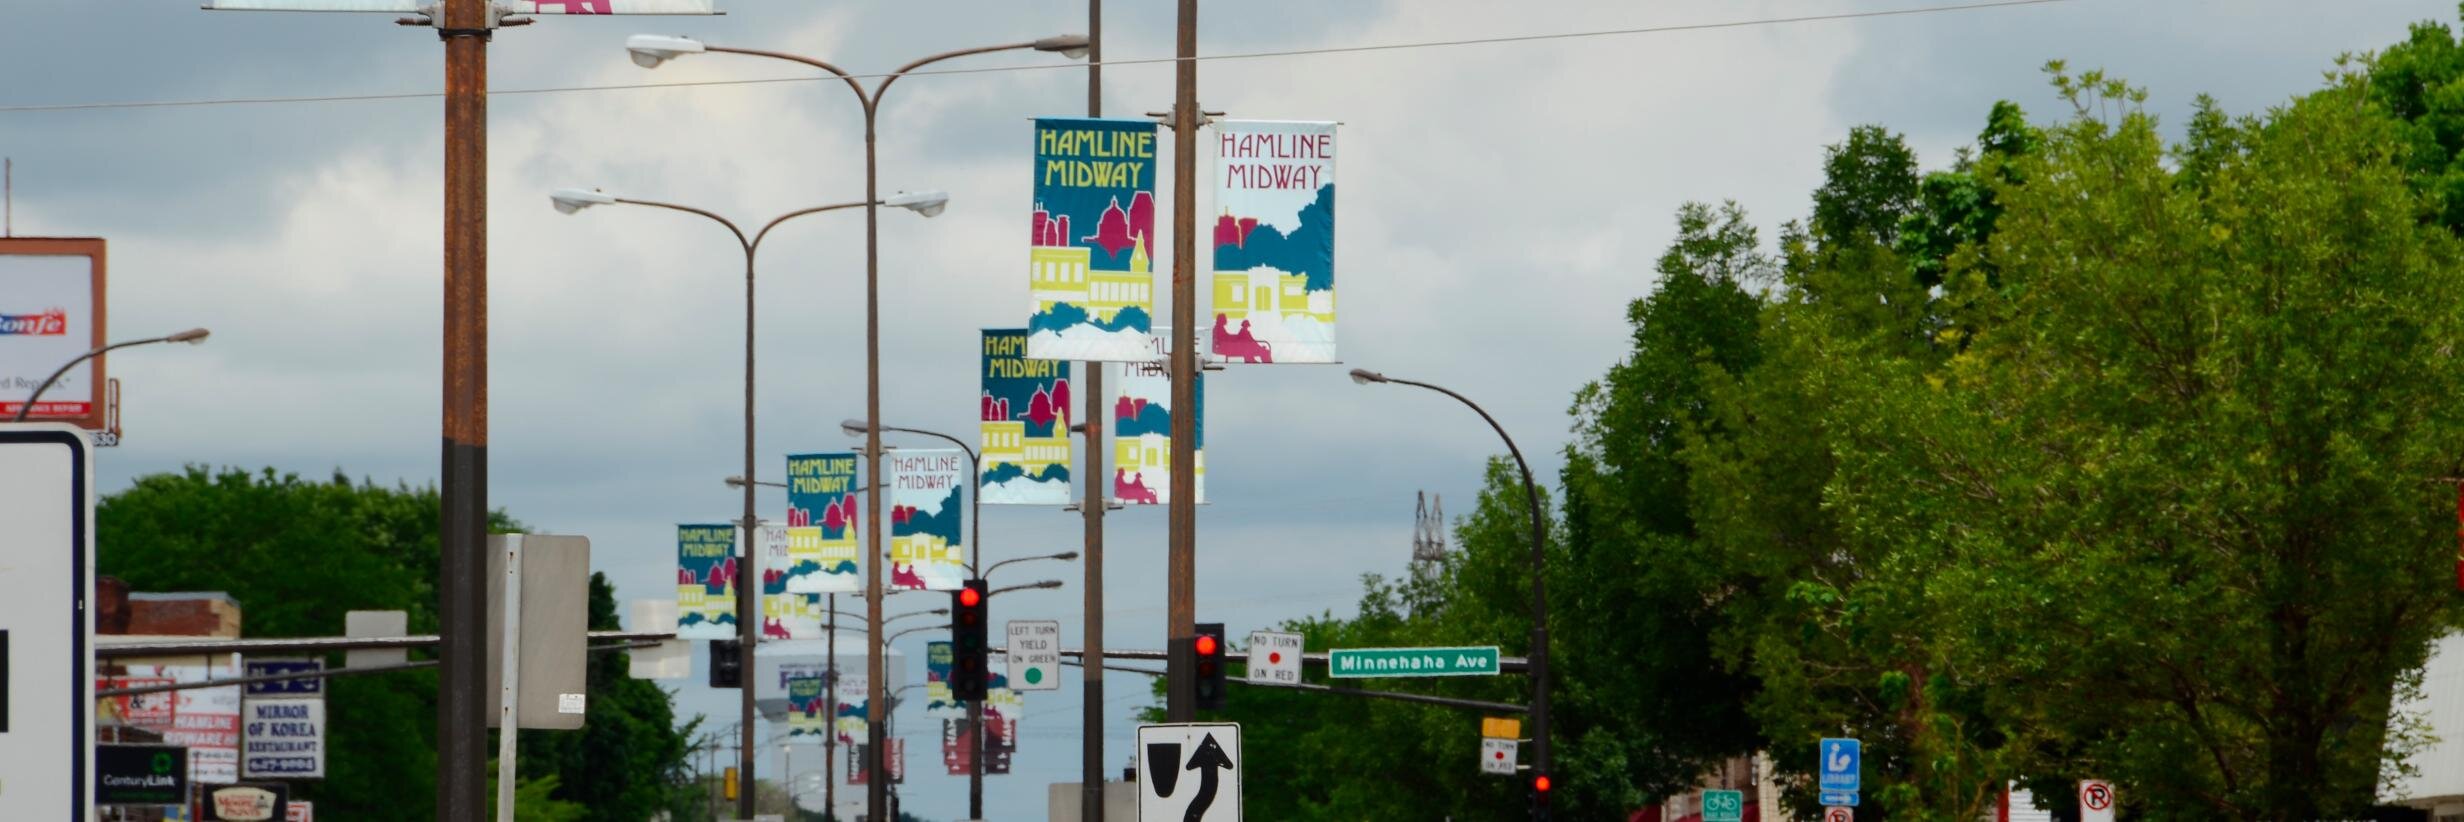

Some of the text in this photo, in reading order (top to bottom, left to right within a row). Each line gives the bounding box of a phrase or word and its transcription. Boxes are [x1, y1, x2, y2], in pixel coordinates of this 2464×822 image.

[1040, 130, 1153, 158] HAMLINE
[1221, 133, 1332, 159] HAMLINE
[1045, 160, 1143, 188] MIDWAY
[1227, 164, 1322, 189] MIDWAY
[989, 358, 1061, 378] MIDWAY
[789, 458, 855, 475] HAMLINE
[894, 455, 959, 472] HAMLINE
[793, 476, 850, 493] MIDWAY
[898, 474, 954, 490] MIDWAY
[679, 528, 735, 542] HAMLINE
[682, 543, 729, 557] MIDWAY
[1010, 625, 1056, 635] LEFT TURN
[1019, 640, 1047, 650] YIELD
[1253, 636, 1298, 648] NO TURN
[1012, 654, 1023, 663] ON
[1029, 654, 1056, 663] GREEN
[1341, 654, 1487, 671] Minnehaha Ave
[1254, 669, 1294, 681] ON RED
[256, 706, 308, 719] MIRROR
[248, 723, 316, 736] OF KOREA
[248, 742, 317, 752] RESTAURANT
[104, 774, 175, 787] CenturyLink
[1822, 774, 1856, 784] LIBRARY
